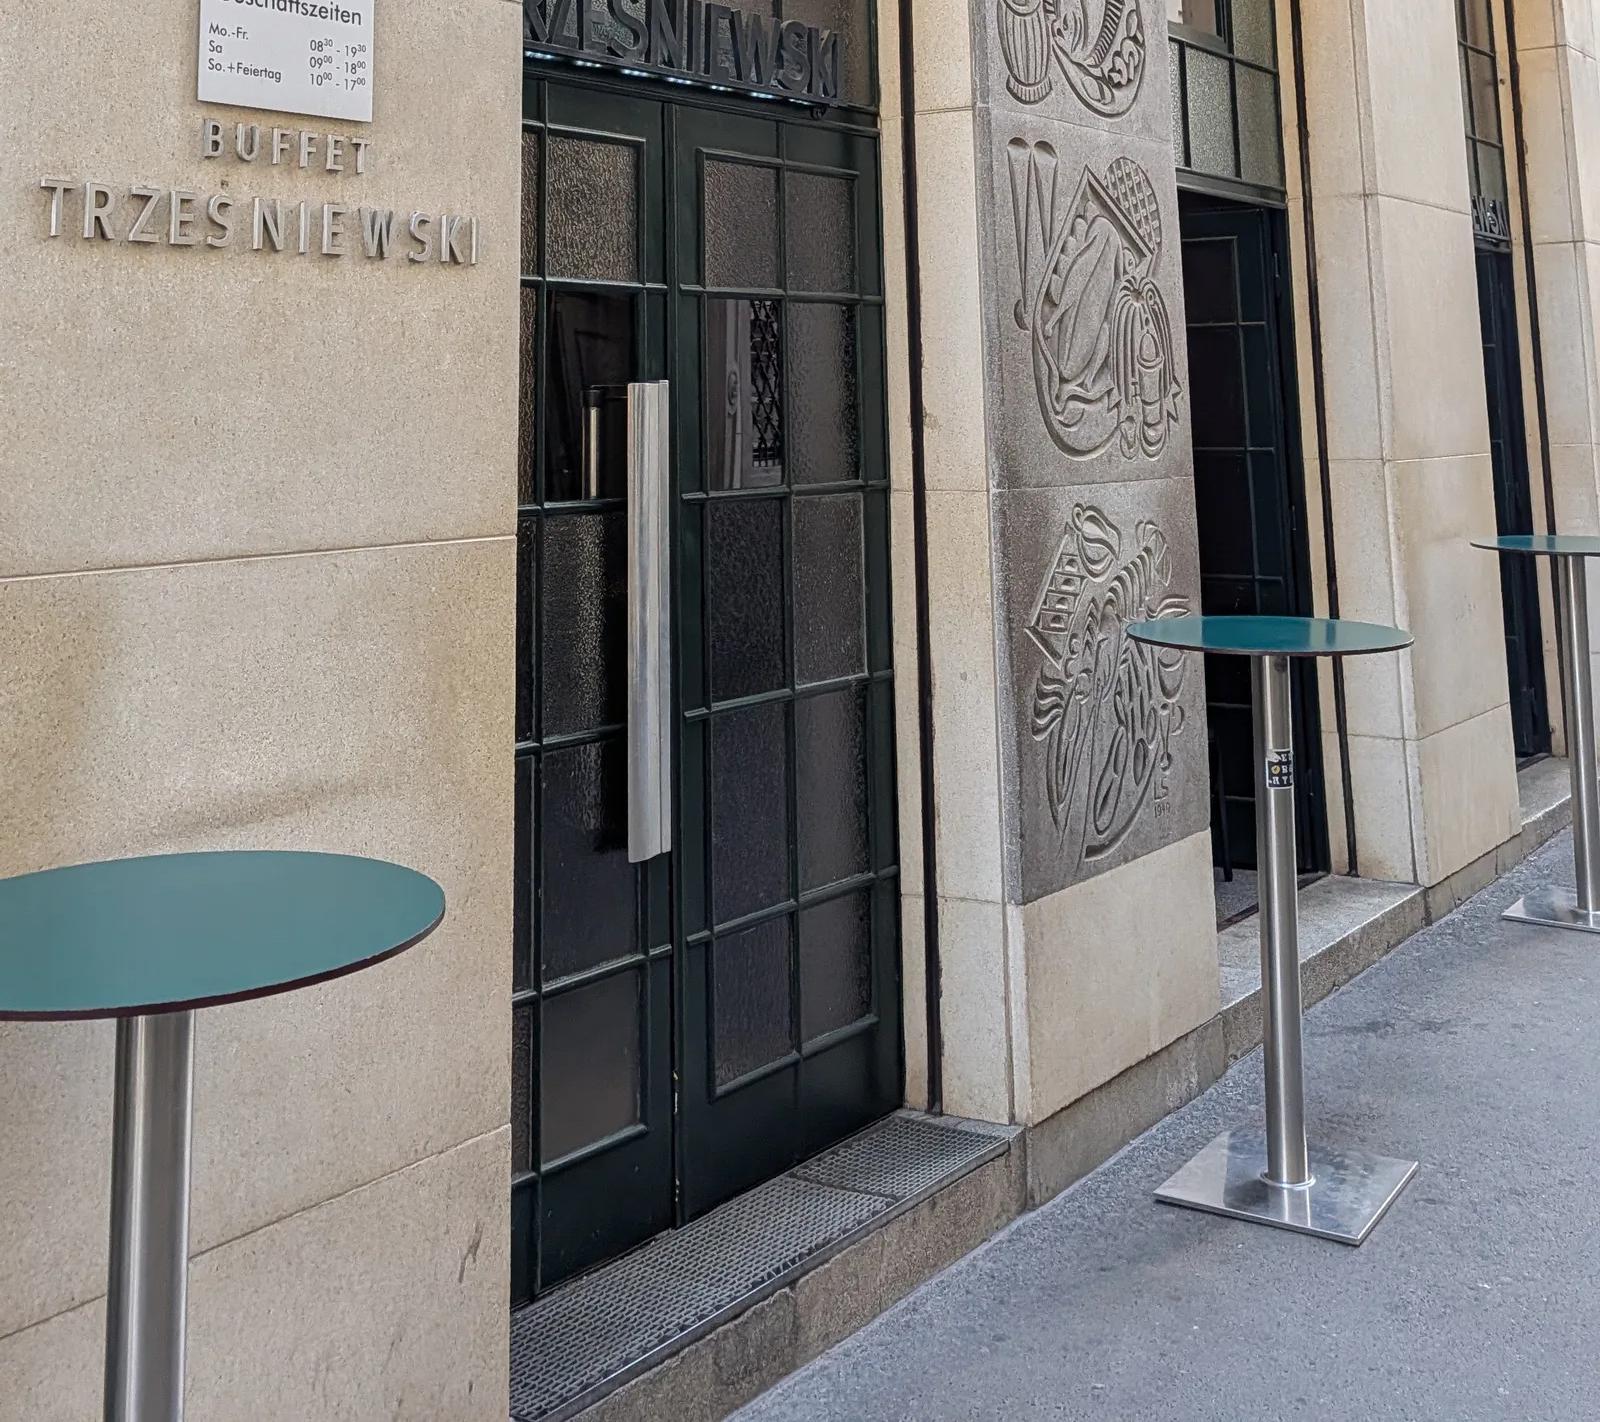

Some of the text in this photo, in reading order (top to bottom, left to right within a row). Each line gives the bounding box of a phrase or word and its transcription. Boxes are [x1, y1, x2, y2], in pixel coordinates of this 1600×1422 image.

[208, 22, 249, 40] Mo.-Fr.
[208, 39, 223, 54] Sa
[202, 118, 371, 174] BUFFET
[39, 178, 480, 265] TRZESNIEWSKI
